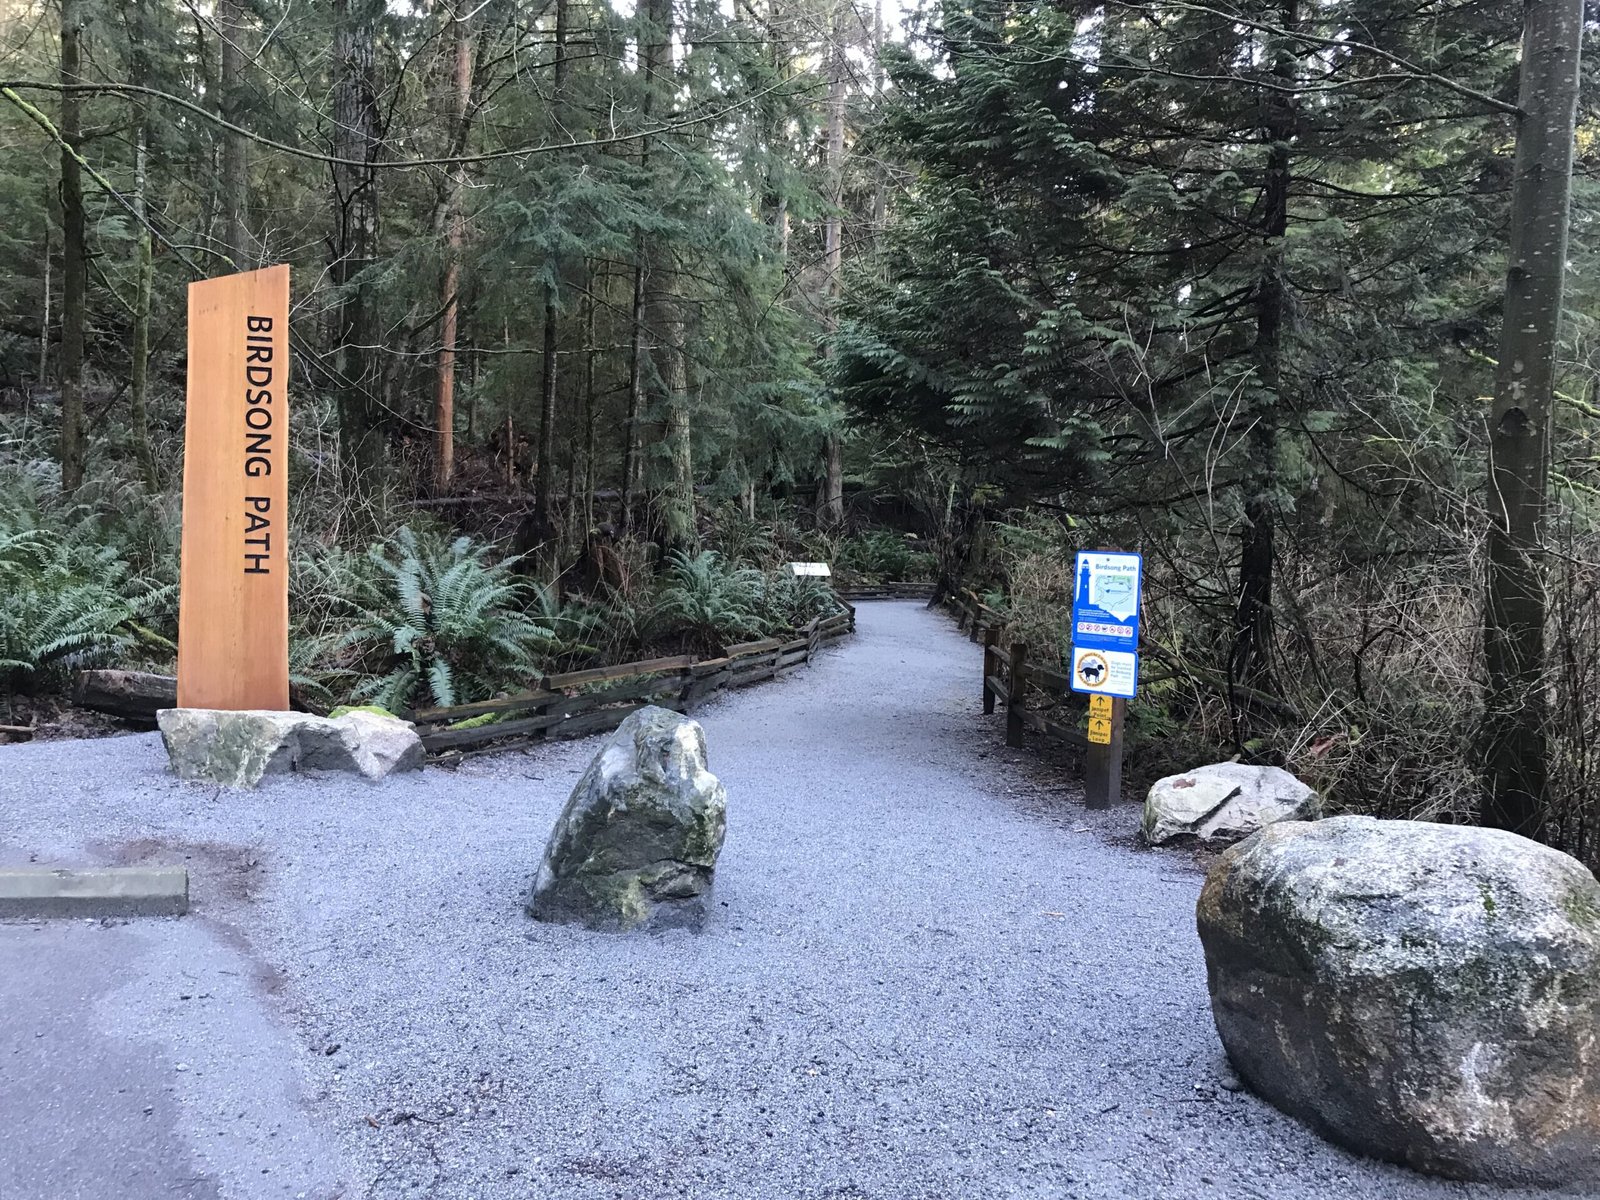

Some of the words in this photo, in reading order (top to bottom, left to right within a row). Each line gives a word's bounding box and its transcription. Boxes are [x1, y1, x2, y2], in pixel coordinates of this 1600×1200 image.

[244, 315, 274, 478] BIRDSONG
[243, 496, 271, 575] PATH
[1095, 563, 1122, 572] Birdsong
[1122, 564, 1137, 572] Path
